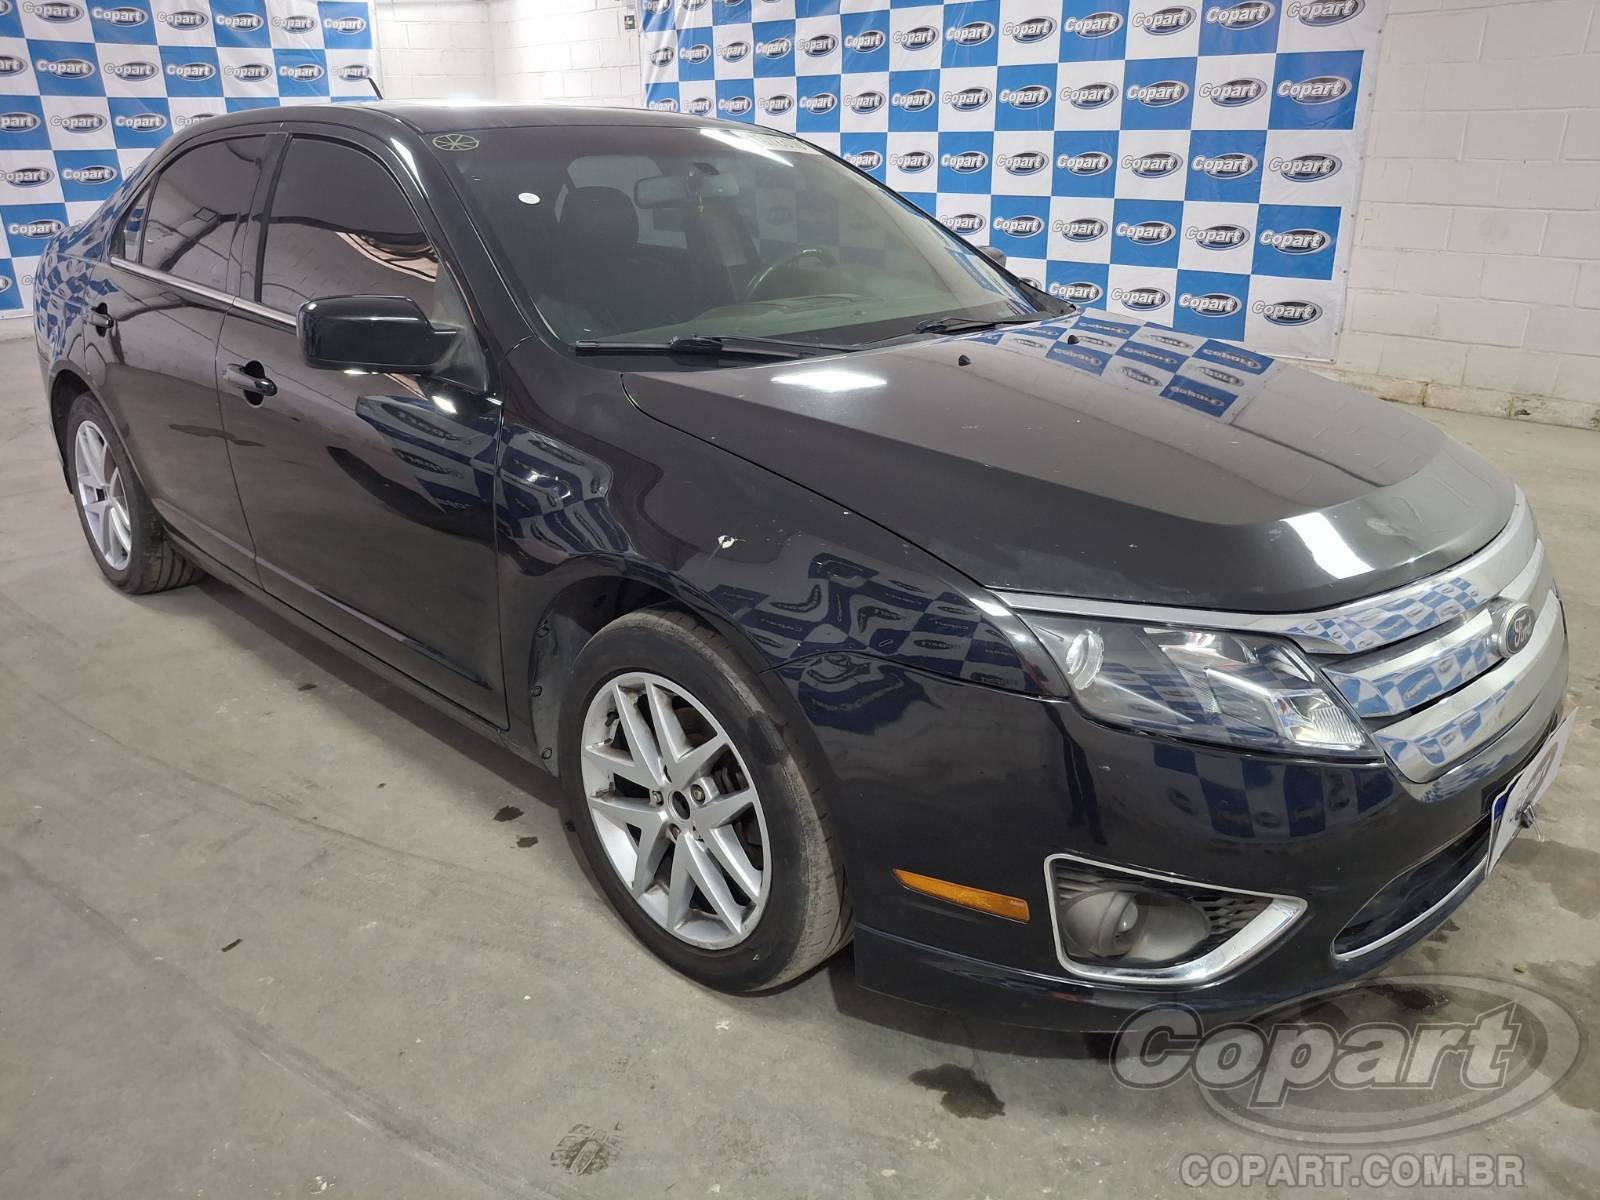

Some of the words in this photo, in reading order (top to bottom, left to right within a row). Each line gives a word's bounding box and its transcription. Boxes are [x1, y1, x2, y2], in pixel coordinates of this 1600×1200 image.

[23, 2, 77, 20] Copart
[92, 8, 142, 24] Copart
[158, 12, 201, 25] Copart
[1206, 4, 1267, 25] Copart
[1287, 0, 1355, 21] Copart
[215, 14, 259, 29] Copart
[271, 16, 312, 31] Copart
[323, 18, 362, 32] Copart
[1003, 20, 1050, 38] Copart
[1064, 14, 1119, 33] Copart
[1132, 10, 1188, 31] Copart
[845, 32, 882, 50] Copart
[893, 28, 936, 47] Copart
[946, 24, 990, 42] Copart
[717, 44, 748, 60] Copart
[756, 41, 788, 57] Copart
[798, 37, 834, 52] Copart
[37, 59, 89, 77] Copart
[104, 63, 151, 78] Copart
[166, 64, 212, 79] Copart
[224, 65, 267, 80] Copart
[279, 65, 319, 80] Copart
[999, 88, 1046, 106] Copart
[1060, 86, 1111, 103] Copart
[1127, 83, 1182, 102] Copart
[1199, 80, 1260, 101] Copart
[1277, 79, 1343, 101] Copart
[718, 98, 748, 112] Copart
[759, 97, 791, 112] Copart
[799, 95, 834, 111] Copart
[844, 93, 881, 110] Copart
[891, 92, 932, 110] Copart
[943, 91, 986, 109] Copart
[0, 115, 34, 130] part
[50, 115, 100, 131] Copart
[115, 115, 162, 130] Copart
[889, 152, 929, 170] Copart
[941, 152, 984, 169] Copart
[996, 153, 1042, 171] Copart
[1056, 153, 1106, 171] Copart
[1121, 154, 1175, 173] Copart
[1192, 154, 1251, 175] Copart
[1269, 156, 1333, 176] Copart
[62, 167, 111, 183] Copart
[9, 222, 58, 235] Copart
[939, 214, 980, 231] Copart
[993, 216, 1039, 233] Copart
[1052, 219, 1102, 237] Copart
[1116, 222, 1169, 240] Copart
[1185, 226, 1242, 245] Copart
[1259, 229, 1322, 249] Copart
[1050, 281, 1097, 300] Copart
[1111, 287, 1163, 306] Copart
[1178, 293, 1234, 313] Copart
[1252, 300, 1314, 321] Copart
